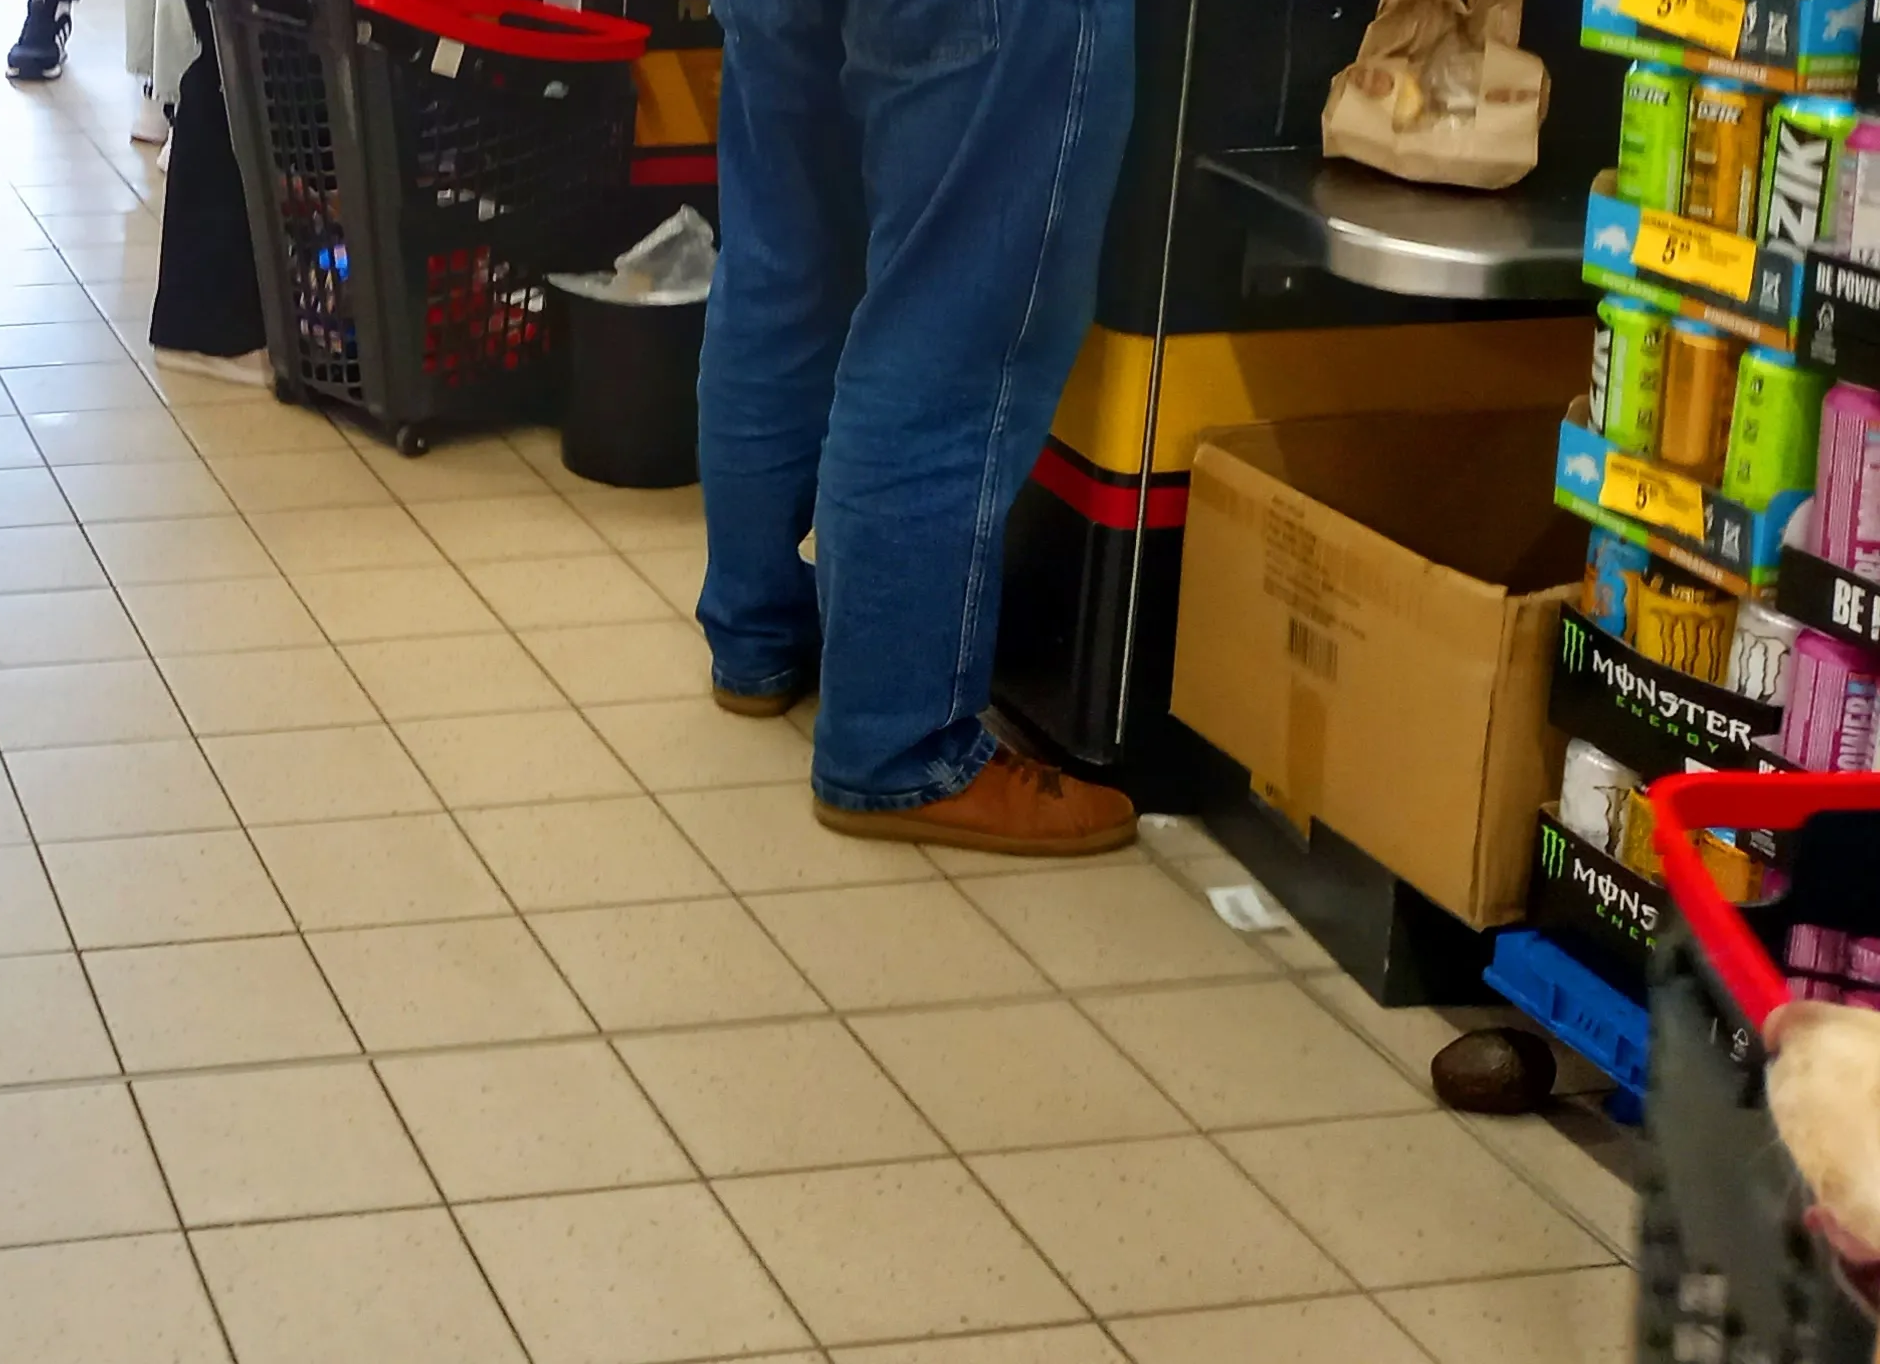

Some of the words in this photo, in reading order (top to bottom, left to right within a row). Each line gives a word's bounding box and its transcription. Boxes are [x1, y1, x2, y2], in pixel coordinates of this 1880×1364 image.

[1836, 267, 1880, 311] POWE
[1832, 577, 1866, 634] BE
[1592, 649, 1752, 751] MONSTER
[1616, 694, 1720, 754] ENERGY
[1836, 695, 1873, 772] OWER
[1573, 857, 1660, 931] MONS
[1596, 902, 1658, 951] ENER
